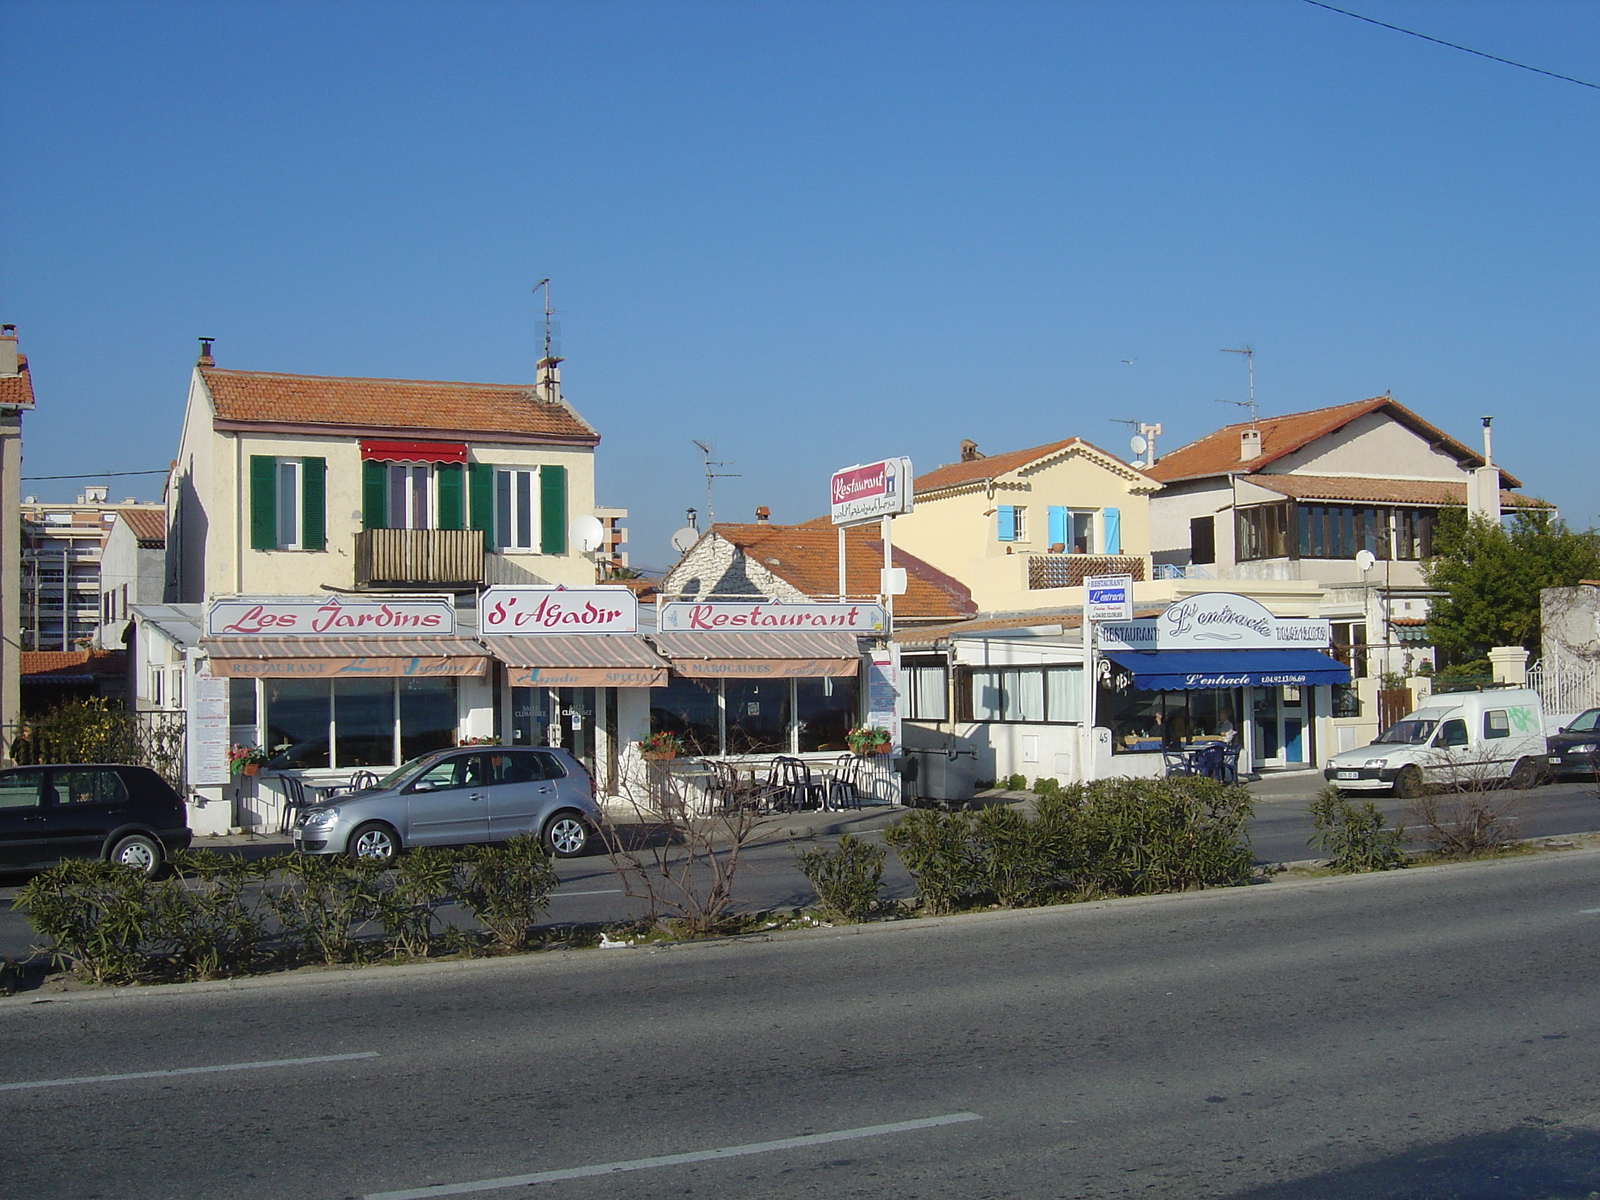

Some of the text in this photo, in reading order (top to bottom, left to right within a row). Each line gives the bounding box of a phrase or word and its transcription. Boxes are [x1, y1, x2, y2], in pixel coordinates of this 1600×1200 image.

[834, 471, 884, 501] Restaurant
[1090, 579, 1124, 588] RESTAURANT
[1090, 590, 1125, 604] L'entracte
[223, 603, 442, 633] Les Jardins
[488, 594, 623, 629] d'Agadir
[688, 604, 859, 630] Restaurant
[1103, 626, 1160, 642] RESTAURANT
[232, 662, 325, 673] RESTAURANT
[340, 659, 391, 674] Les
[401, 657, 465, 675] Jardins
[693, 664, 771, 673] MAROCAINES
[516, 667, 581, 685] Agadir
[1184, 673, 1251, 686] L'entracte
[1099, 732, 1109, 744] 45
